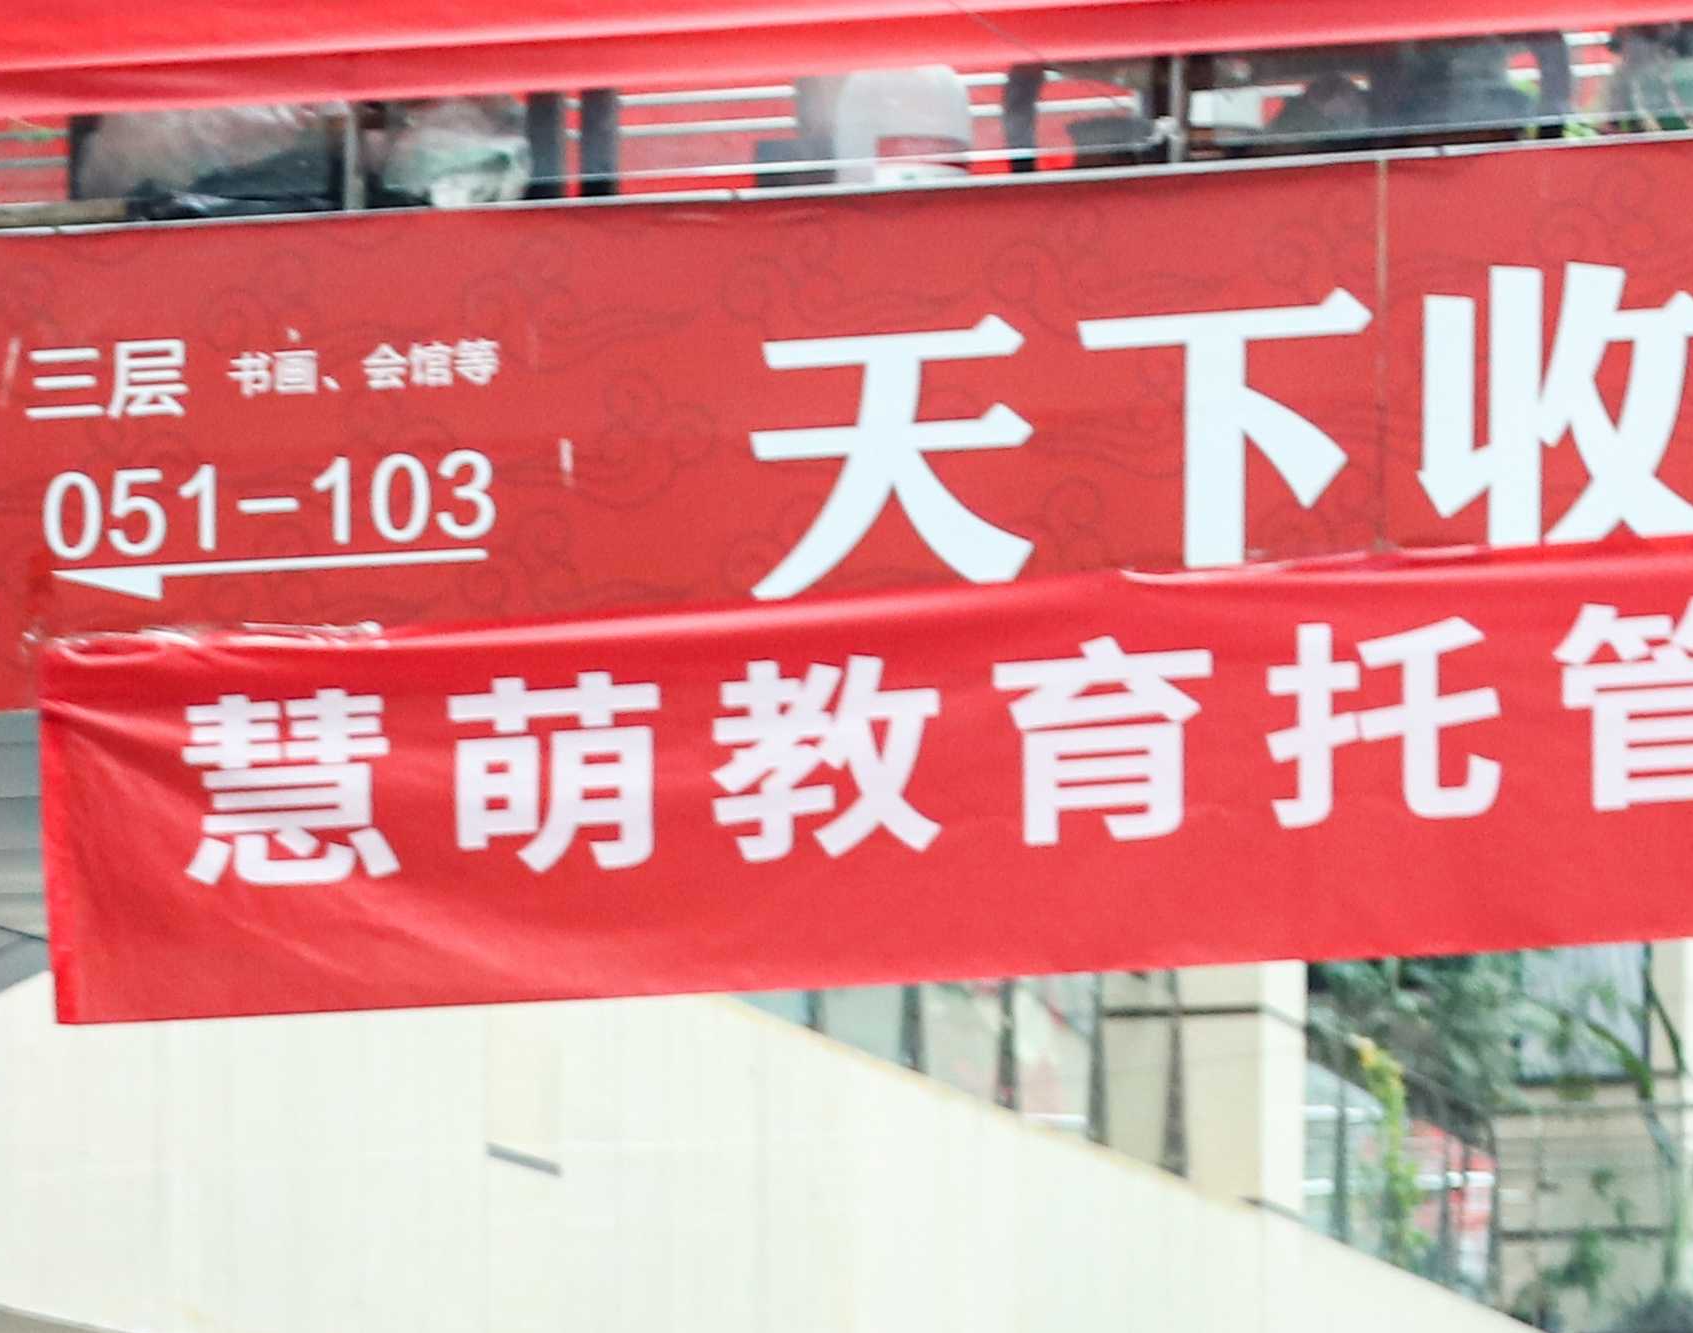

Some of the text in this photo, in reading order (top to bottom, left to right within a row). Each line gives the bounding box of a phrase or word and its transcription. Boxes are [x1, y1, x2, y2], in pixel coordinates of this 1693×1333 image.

[25, 338, 501, 420] 三层 书画、会馆等
